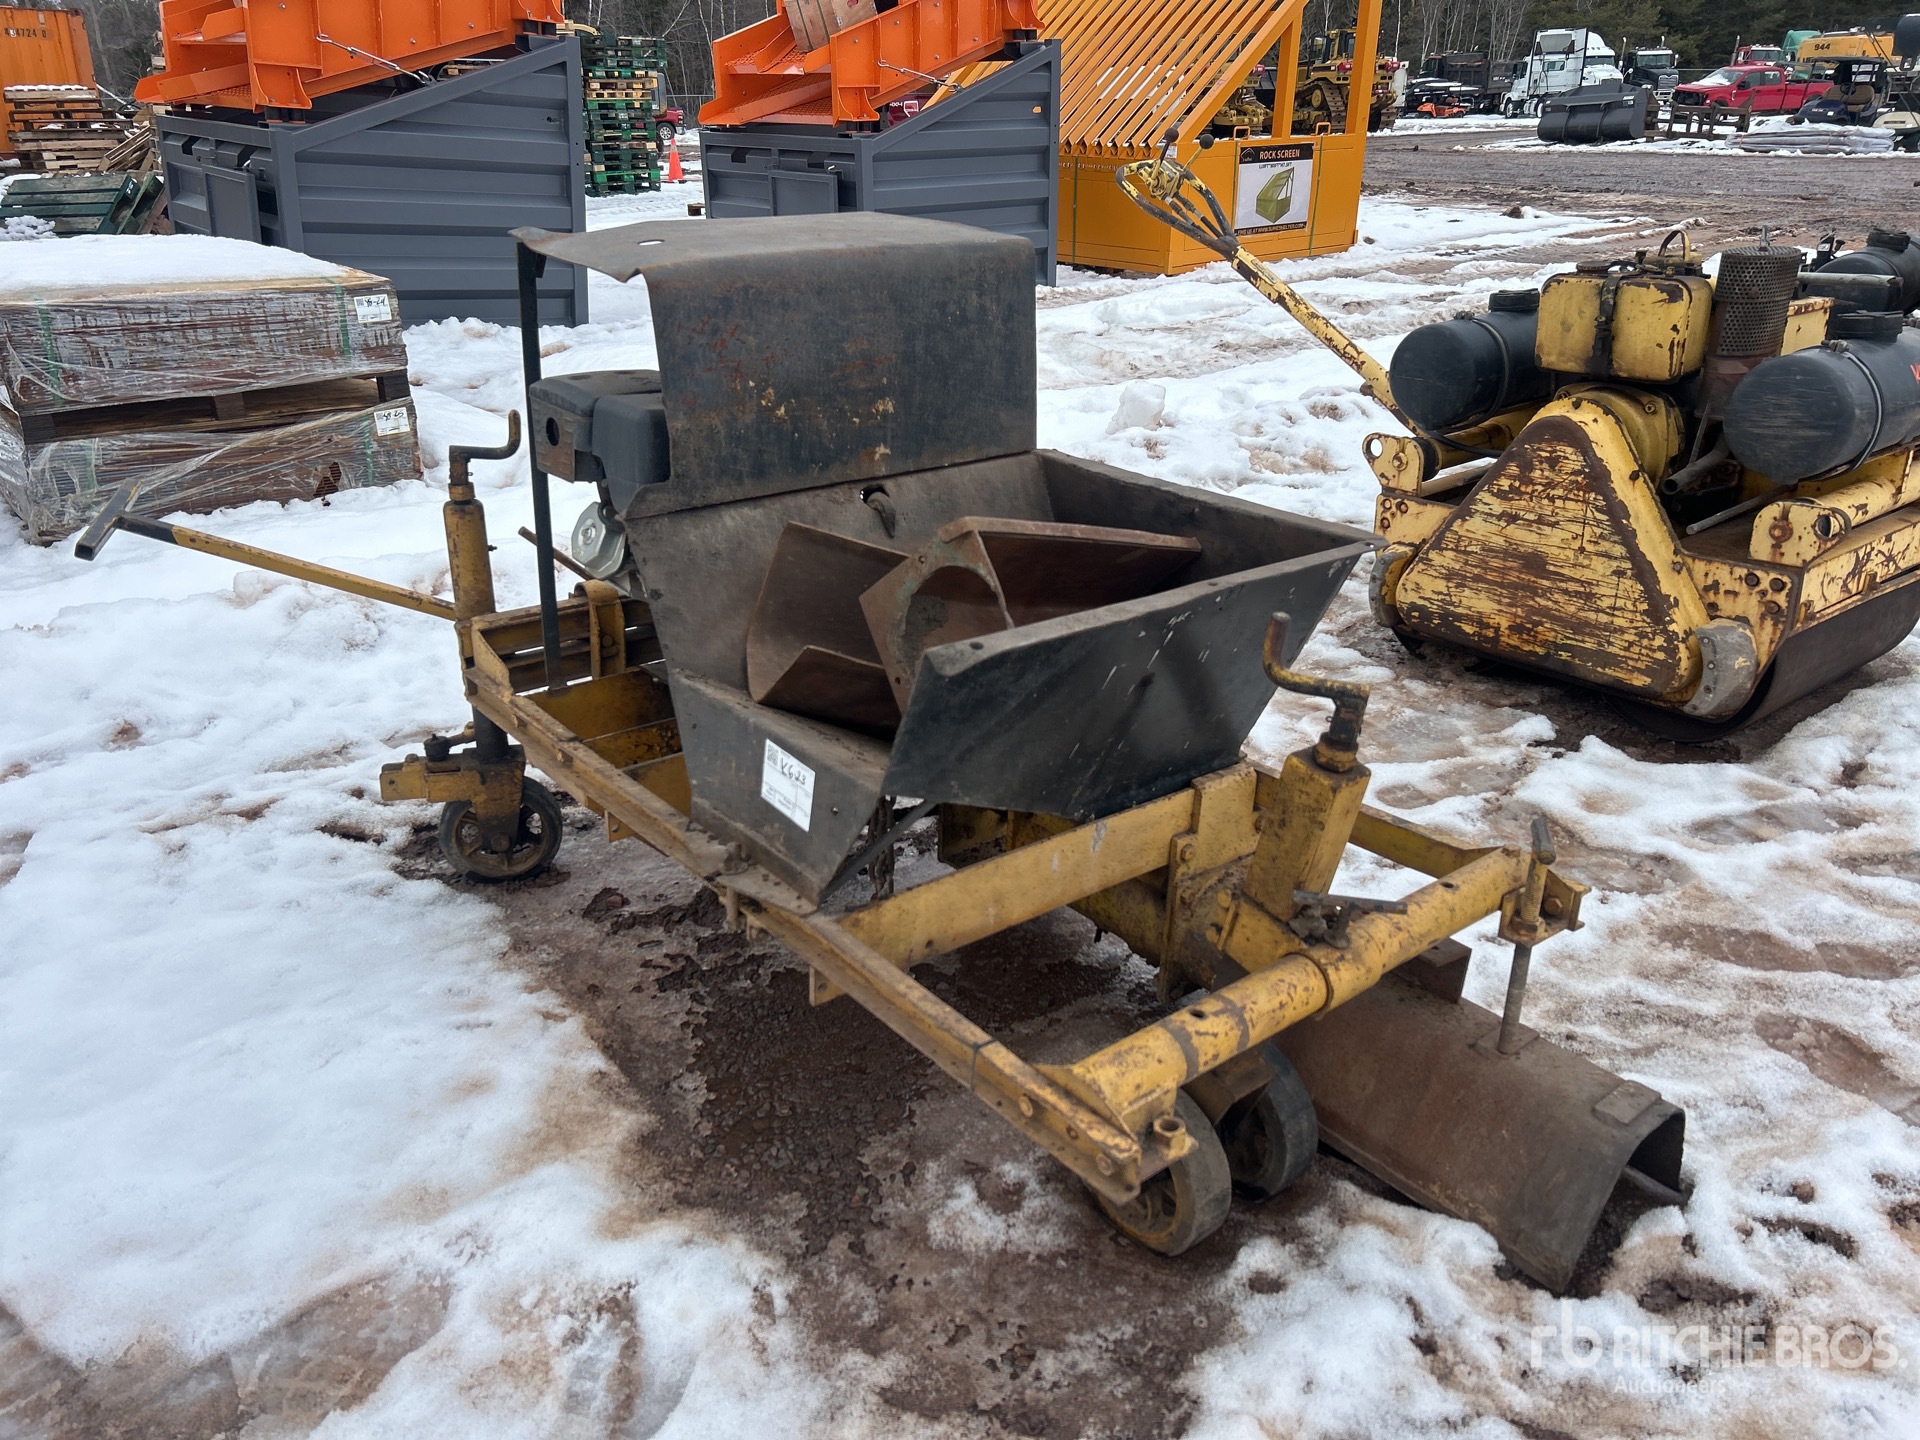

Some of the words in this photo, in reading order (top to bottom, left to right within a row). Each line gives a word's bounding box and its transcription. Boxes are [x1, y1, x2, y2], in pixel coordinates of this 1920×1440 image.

[1814, 43, 1831, 51] 944
[1259, 150, 1277, 160] ROCK
[1277, 149, 1300, 159] SCREEN
